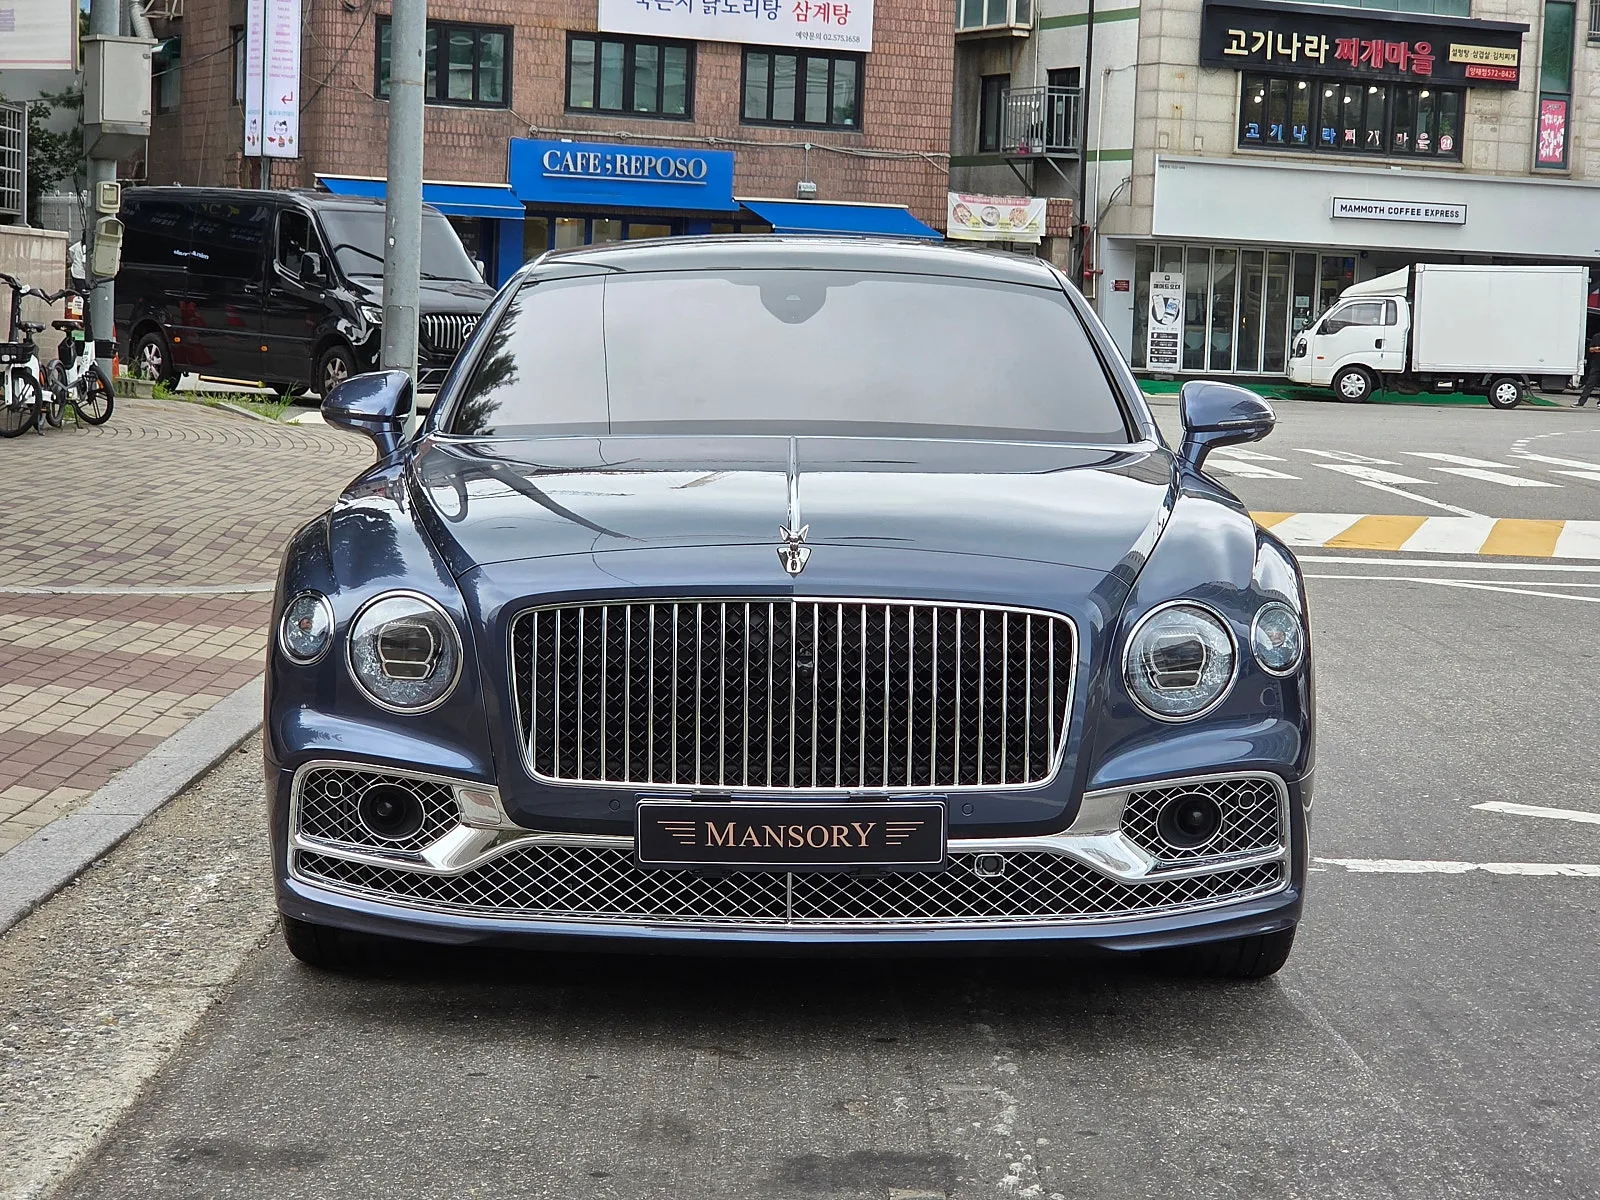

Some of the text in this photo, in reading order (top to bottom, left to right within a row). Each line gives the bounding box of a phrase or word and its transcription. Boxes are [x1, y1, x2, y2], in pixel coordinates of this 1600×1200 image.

[792, 1, 852, 25] 삼계탕
[796, 31, 822, 41] 예약문의
[1224, 28, 1436, 75] 고기나라 찌개마을
[1340, 203, 1460, 218] MAMMOTH COFFEE EXPRESS
[705, 821, 877, 848] MANSORY
